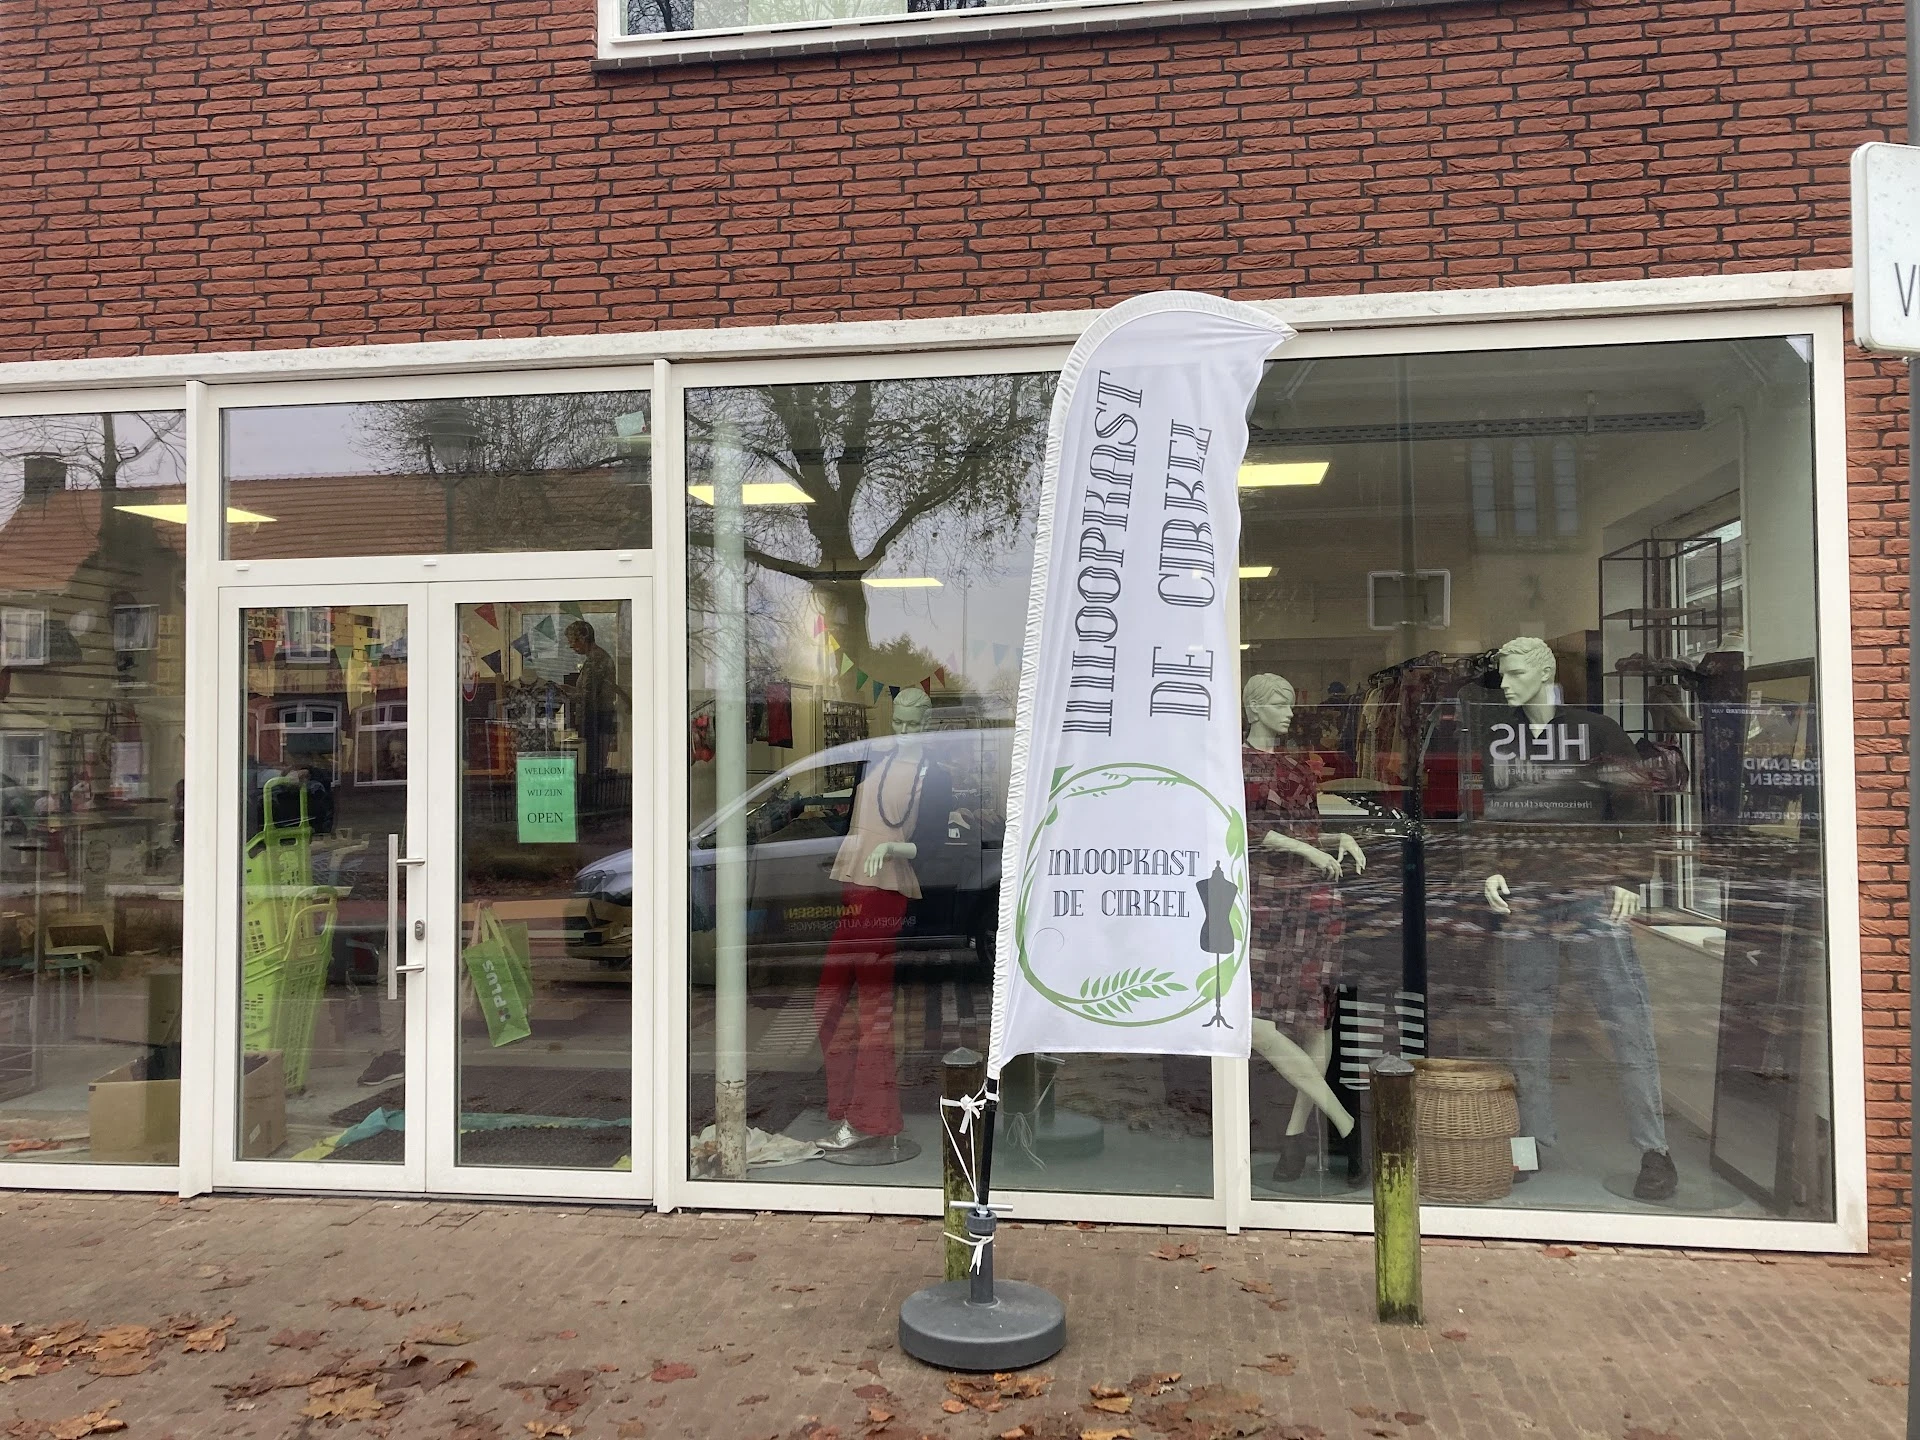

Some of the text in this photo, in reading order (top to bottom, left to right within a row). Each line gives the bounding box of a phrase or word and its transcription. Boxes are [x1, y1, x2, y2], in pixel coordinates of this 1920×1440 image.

[1894, 262, 1920, 317] V
[1062, 369, 1143, 737] INLOOPKAST
[1150, 418, 1215, 721] DE CIRKEL
[525, 767, 565, 775] WELKOM
[527, 788, 563, 796] WIJ ZIJN
[527, 812, 563, 823] OPEN
[1047, 848, 1200, 877] INLOOPKAST
[1053, 889, 1190, 918] DE CIRKEL
[482, 959, 507, 1008] PLUS
